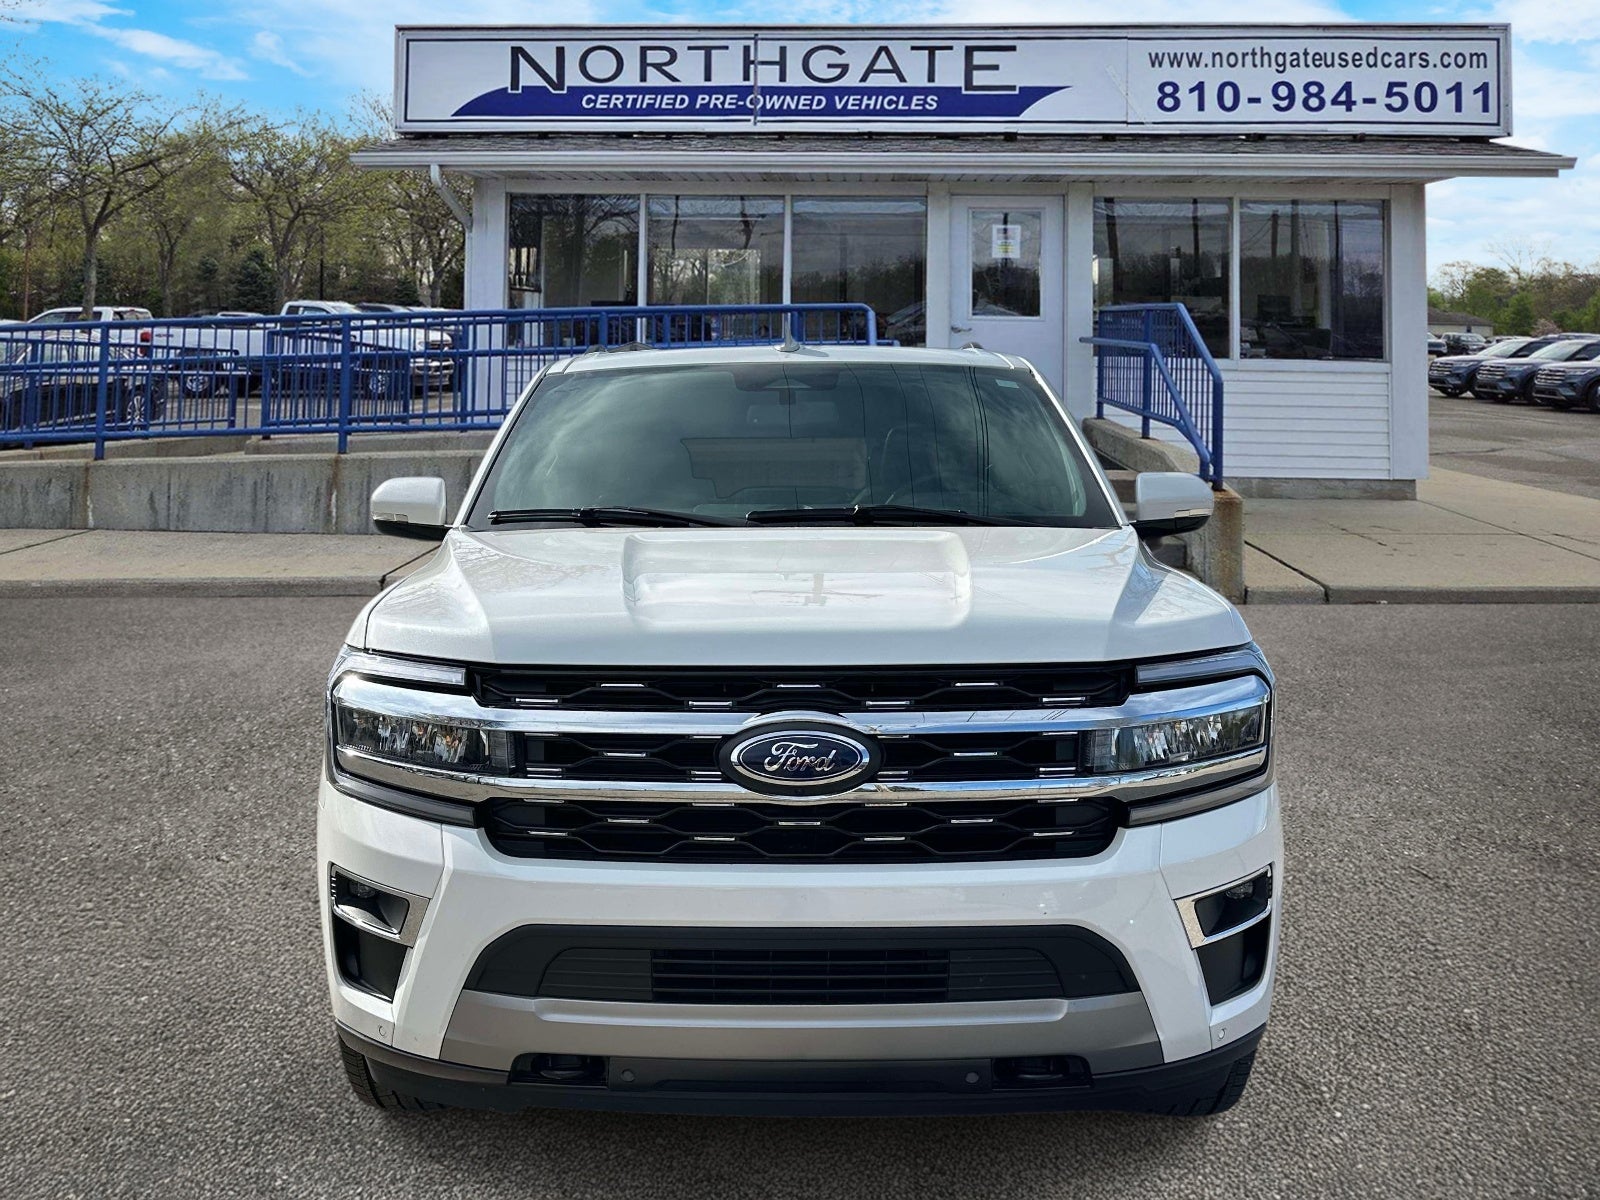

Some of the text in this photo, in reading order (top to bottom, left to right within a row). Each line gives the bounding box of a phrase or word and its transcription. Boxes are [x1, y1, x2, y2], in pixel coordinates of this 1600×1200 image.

[509, 44, 1017, 92] NORTHGATE
[1148, 46, 1488, 74] www.northgateusedcars.com
[581, 94, 939, 111] CERTIFIED PRE-OWNED VEHICLES
[1156, 80, 1490, 113] 810-984-5011
[763, 741, 837, 772] Ford
